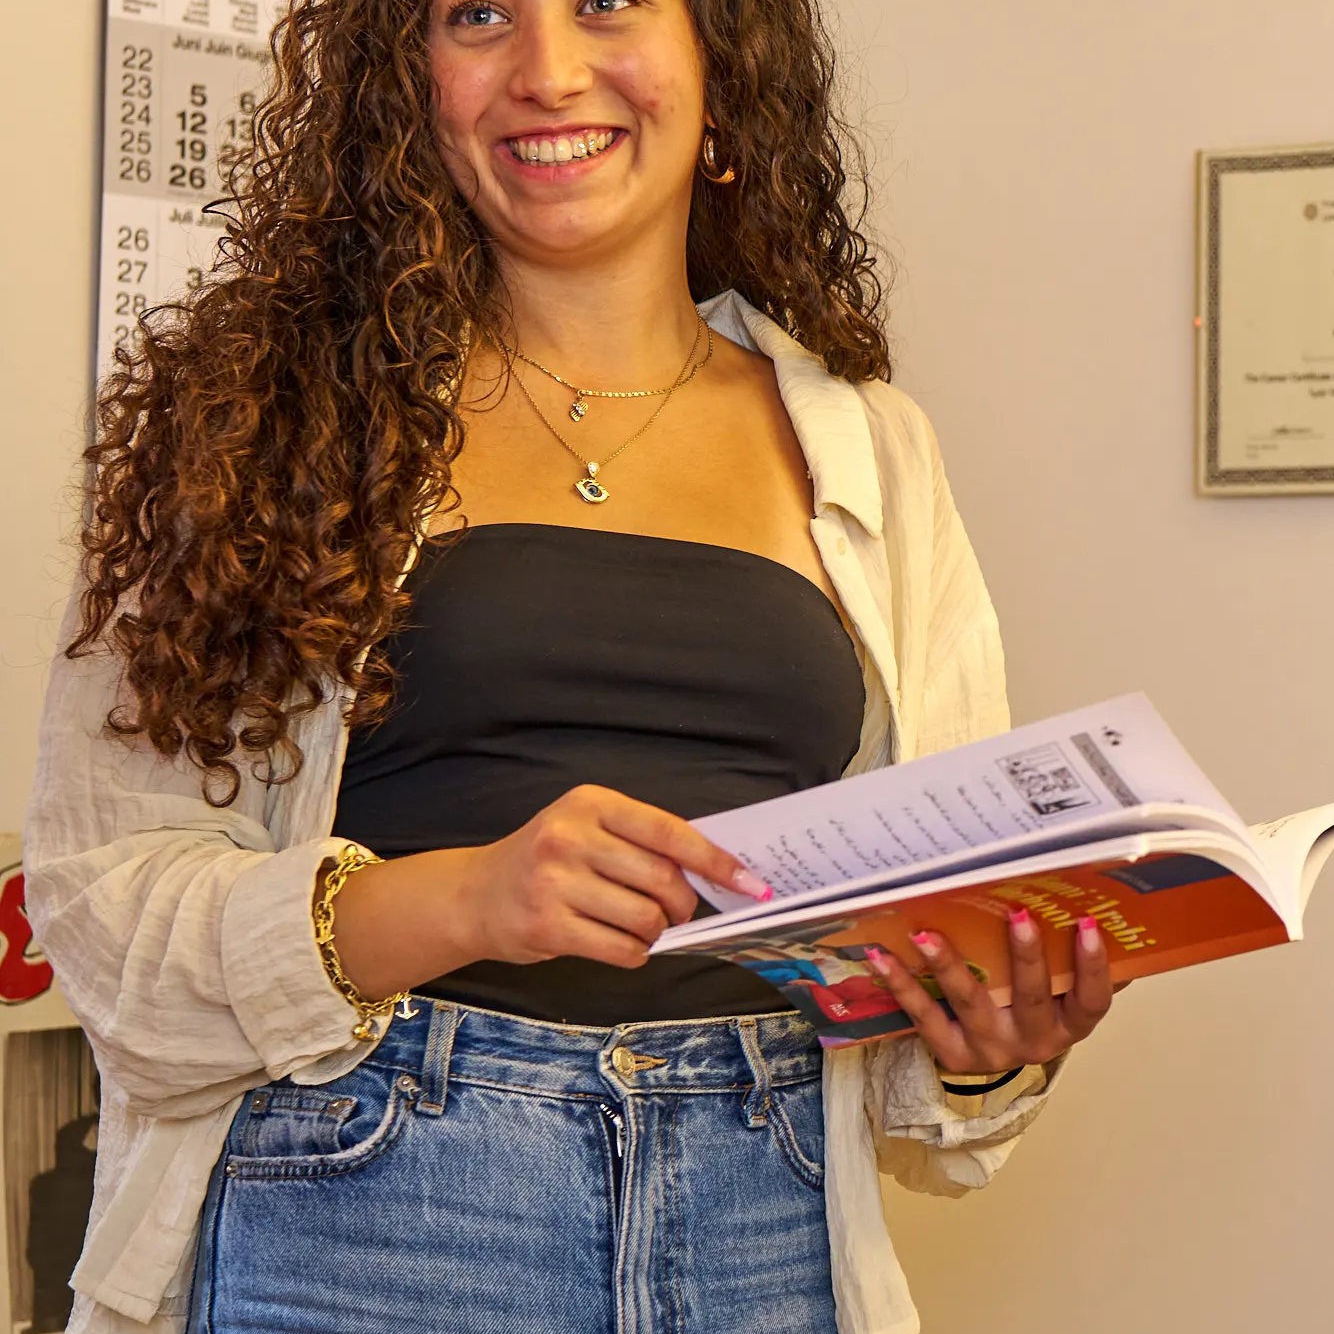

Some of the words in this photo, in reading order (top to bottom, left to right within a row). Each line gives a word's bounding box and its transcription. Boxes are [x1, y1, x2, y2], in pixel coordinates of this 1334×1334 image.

[121, 44, 153, 72] 22
[121, 73, 153, 100] 23
[190, 83, 208, 109] 5
[240, 91, 256, 115] 6
[120, 101, 151, 127] 24
[176, 110, 208, 136] 12
[120, 129, 152, 156] 25
[175, 138, 207, 163] 19
[119, 157, 151, 184] 26
[168, 164, 207, 190] 26
[117, 225, 150, 253] 26
[117, 258, 148, 285] 27
[115, 291, 147, 319] 28
